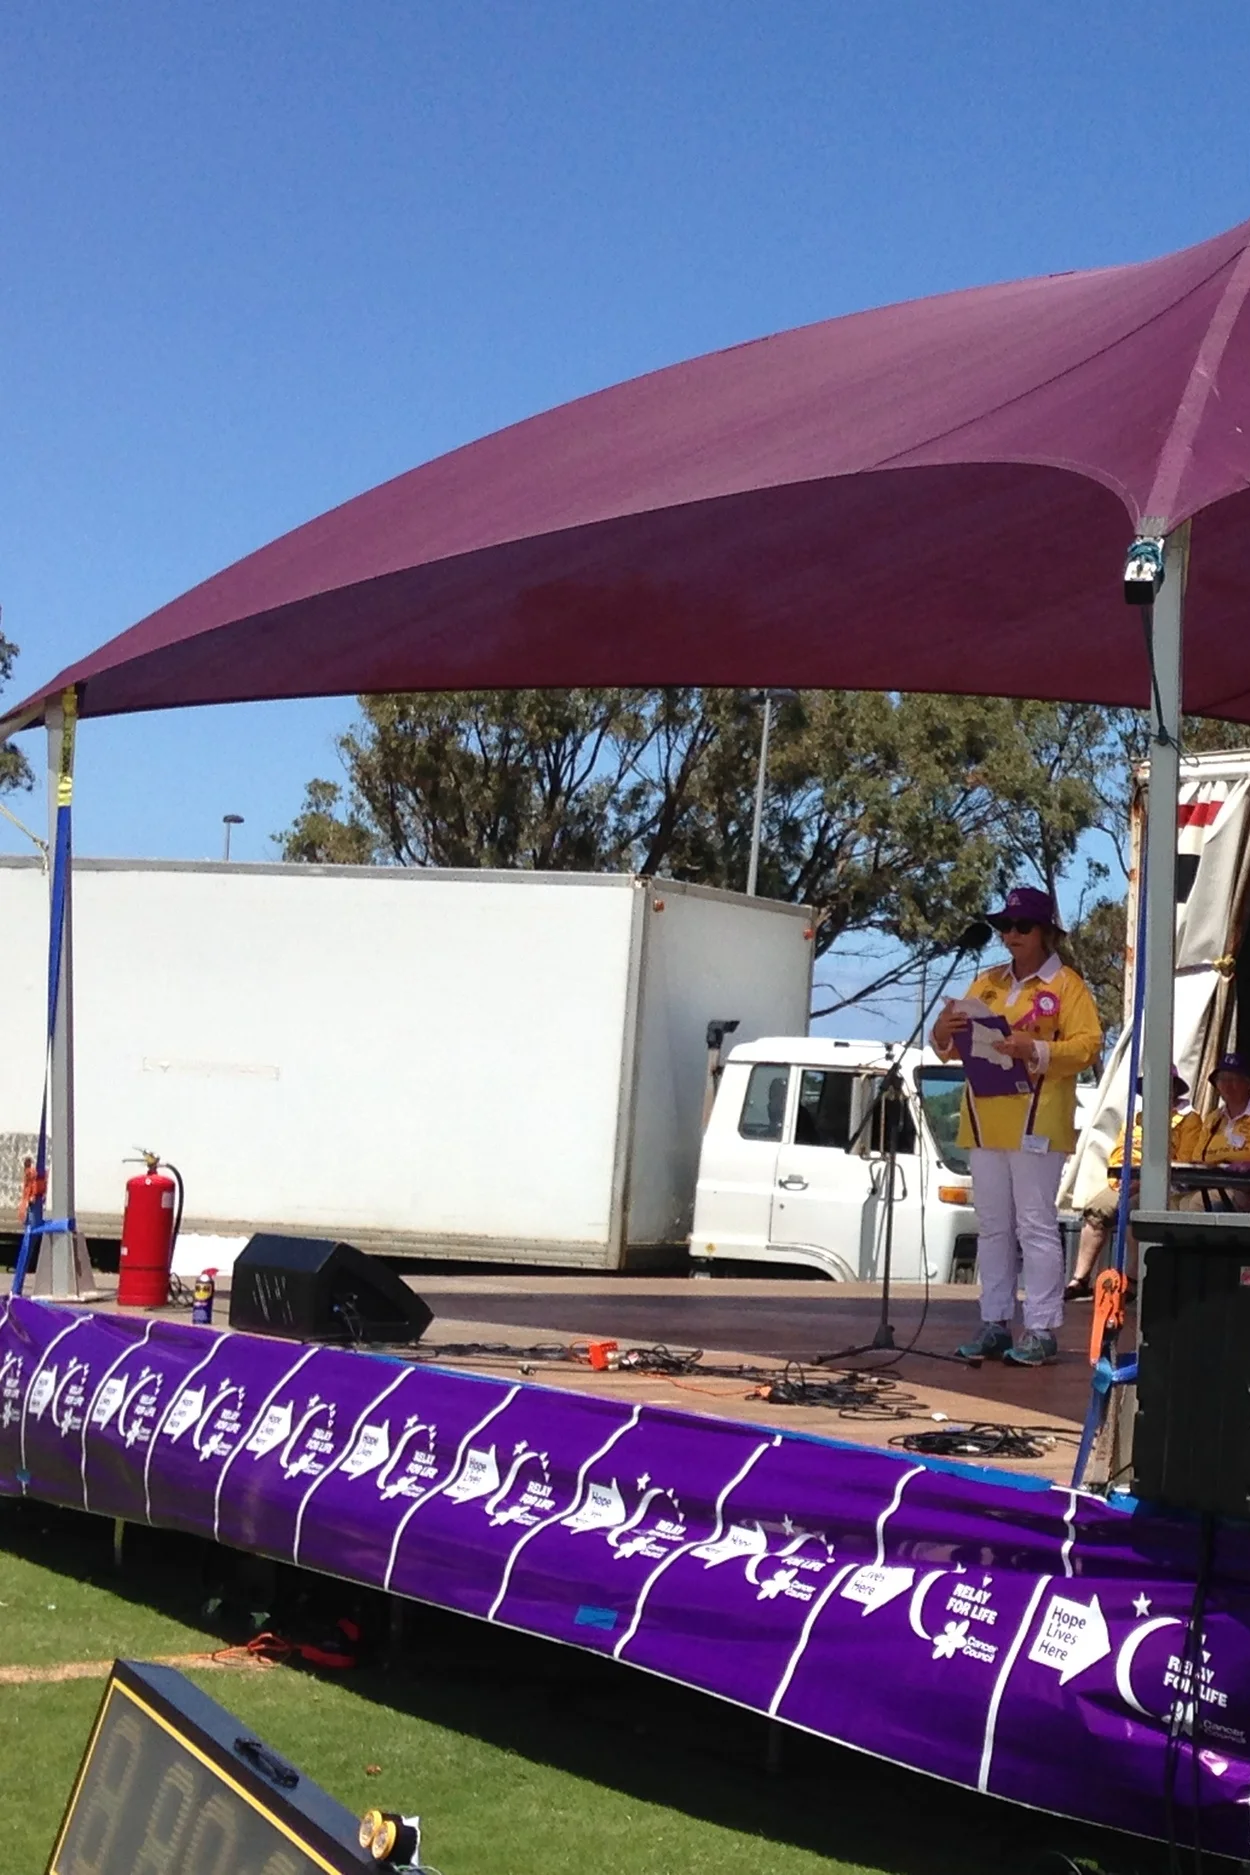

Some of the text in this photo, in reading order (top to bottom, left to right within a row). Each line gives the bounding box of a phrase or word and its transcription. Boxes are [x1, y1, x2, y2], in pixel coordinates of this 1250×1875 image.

[953, 1582, 992, 1605] RELAY
[945, 1597, 998, 1625] FOR LIFE
[1051, 1606, 1087, 1630] Hope
[1046, 1622, 1079, 1646] Lives
[1038, 1639, 1069, 1662] Here
[1200, 1683, 1228, 1708] LIFE
